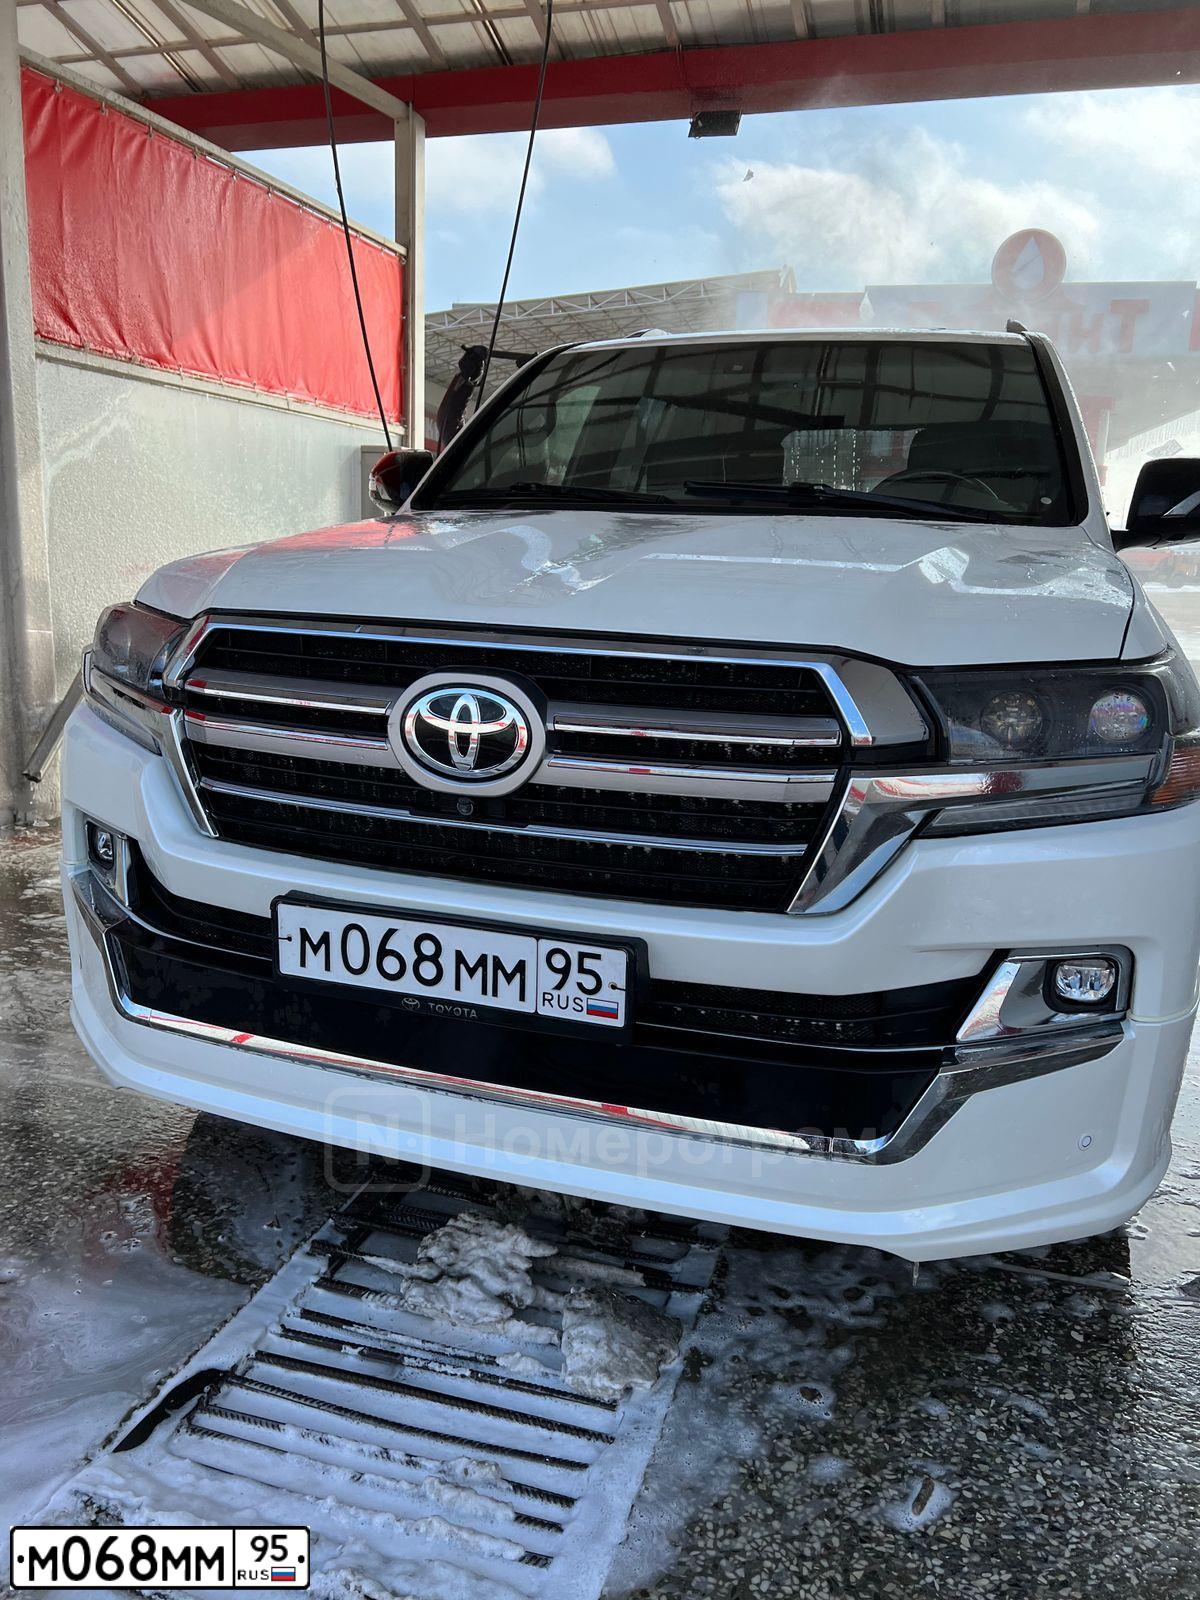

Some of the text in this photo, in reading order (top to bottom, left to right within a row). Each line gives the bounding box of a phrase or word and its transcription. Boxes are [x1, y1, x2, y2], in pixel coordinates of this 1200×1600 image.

[299, 923, 603, 1002] М068ММ 95
[428, 1002, 478, 1020] TOYOTA
[542, 992, 584, 1013] RUS
